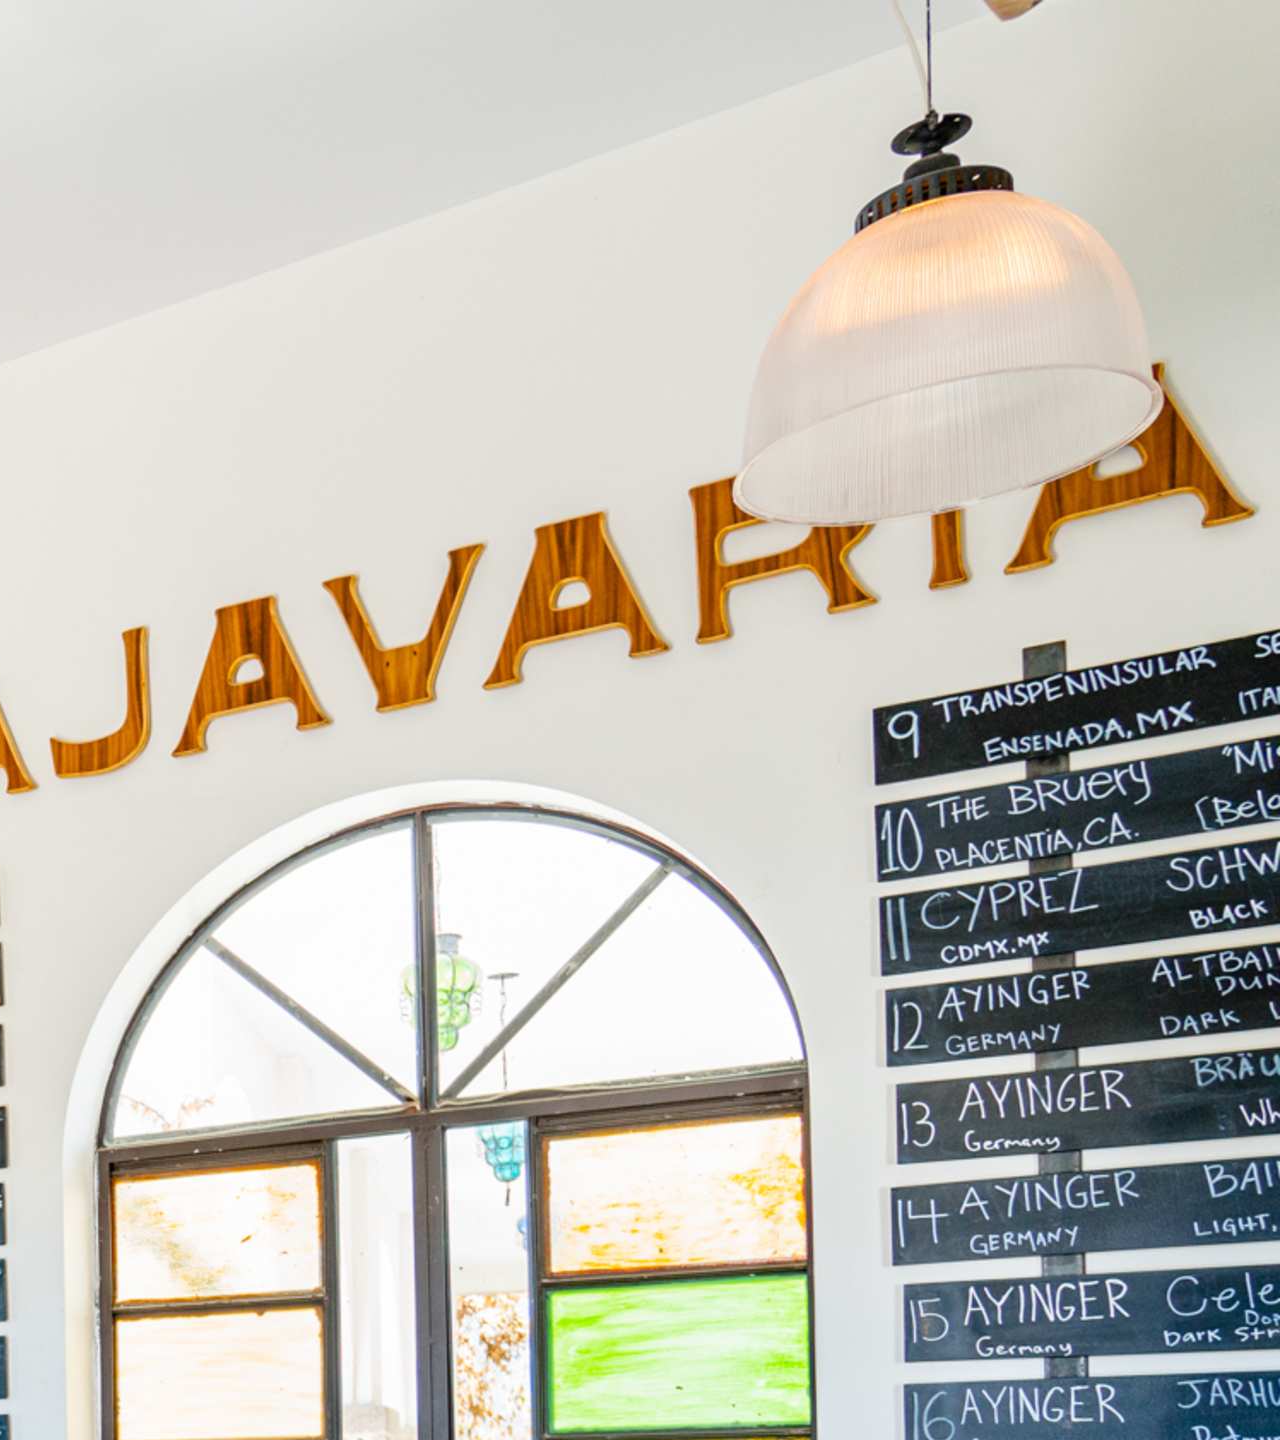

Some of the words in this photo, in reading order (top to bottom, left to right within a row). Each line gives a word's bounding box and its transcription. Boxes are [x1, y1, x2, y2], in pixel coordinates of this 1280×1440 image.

[887, 710, 919, 759] 9
[933, 646, 1216, 723] TRANSPENINSULAR
[983, 718, 1133, 762] ENSENADA,
[1137, 702, 1195, 738] MX
[1239, 687, 1280, 716] ITA
[880, 808, 923, 873] 10
[927, 795, 989, 829] THE
[886, 897, 909, 961] 11
[920, 869, 1098, 932] CYPREZ
[1189, 899, 1268, 930] BLACK
[892, 1000, 928, 1052] 12
[938, 969, 1091, 1023] AYINGER
[1151, 946, 1280, 988] ALTBAI
[945, 1023, 1061, 1056] GERMANY
[1160, 1008, 1240, 1036] DARK
[901, 1101, 936, 1147] 13
[958, 1068, 1132, 1122] AYINGER
[964, 1129, 1060, 1154] Germany
[896, 1198, 949, 1249] 14
[960, 1169, 1139, 1221] AYINGER
[1203, 1162, 1280, 1199] BAI
[969, 1225, 1079, 1256] GERMANY
[1193, 1214, 1278, 1237] LIGHT,
[909, 1298, 949, 1344] 15
[964, 1278, 1130, 1327] AYINGER
[975, 1335, 1073, 1358] Germany
[961, 1383, 1125, 1425] AYINGER
